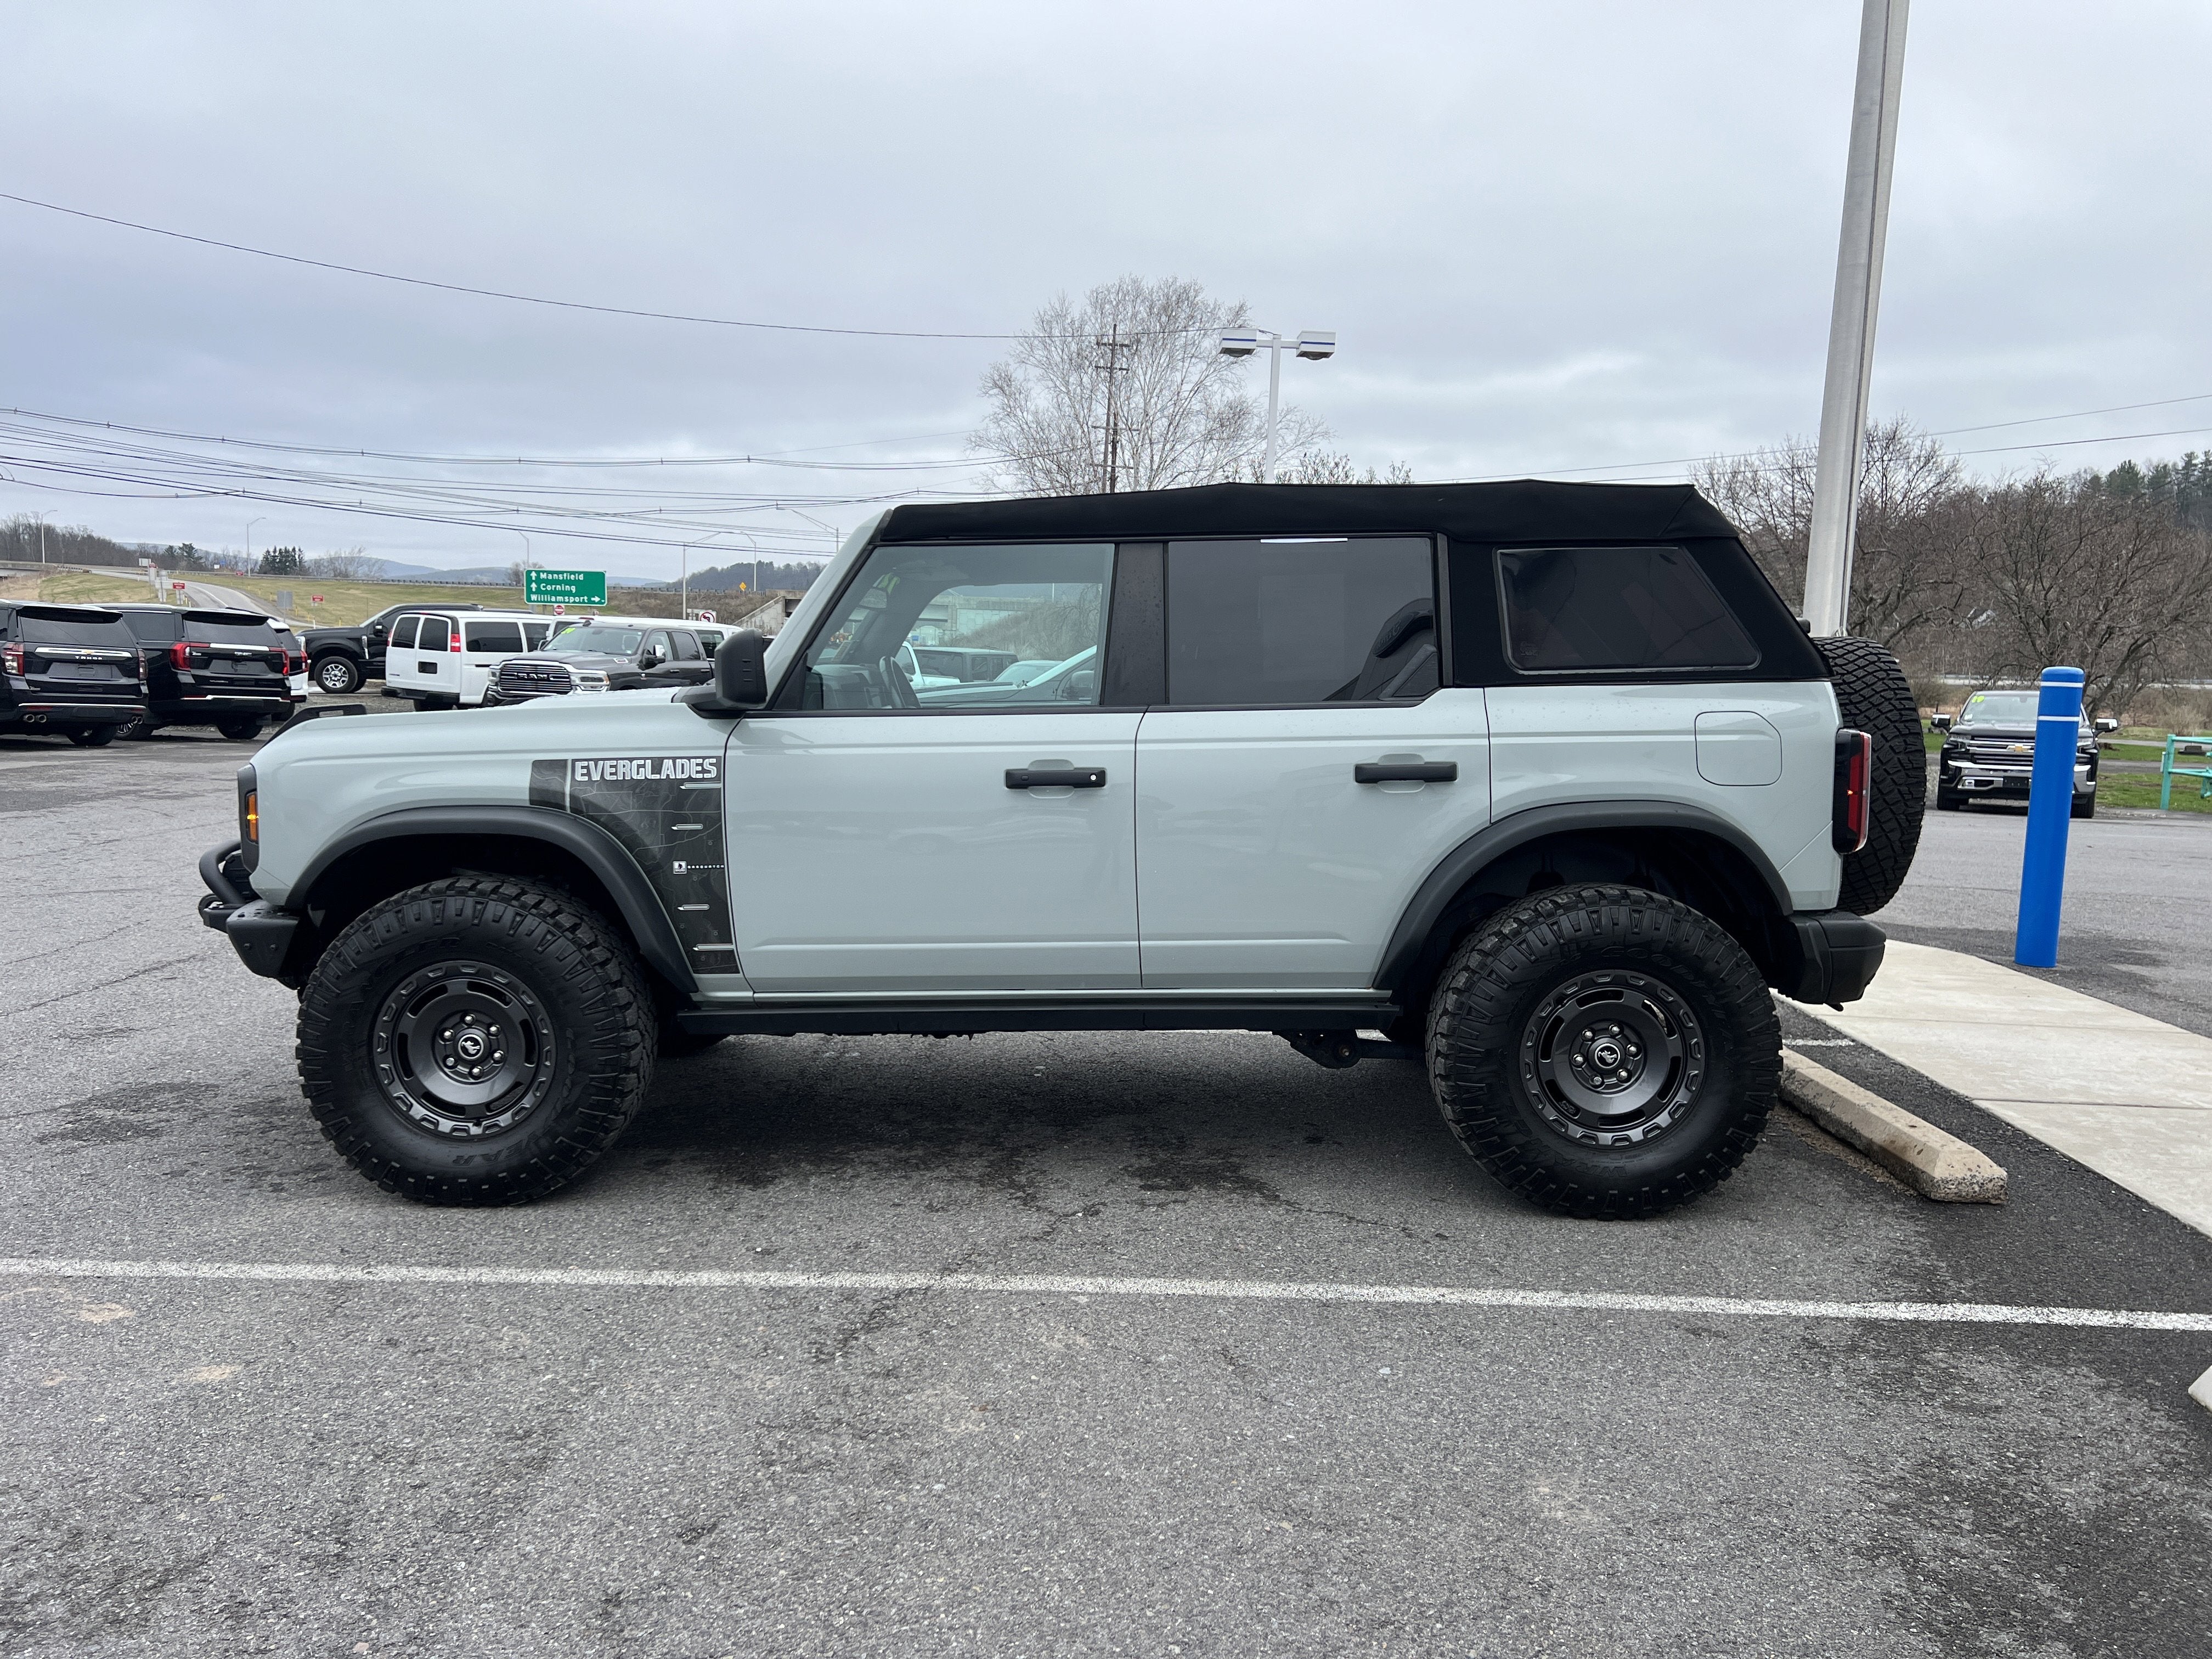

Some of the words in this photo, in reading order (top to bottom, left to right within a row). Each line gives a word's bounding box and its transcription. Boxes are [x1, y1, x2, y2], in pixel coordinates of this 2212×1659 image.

[540, 572, 584, 580] Mansfield
[540, 583, 575, 593] Corning
[531, 594, 588, 603] Williamsport
[574, 758, 717, 781] EVERGLADES
